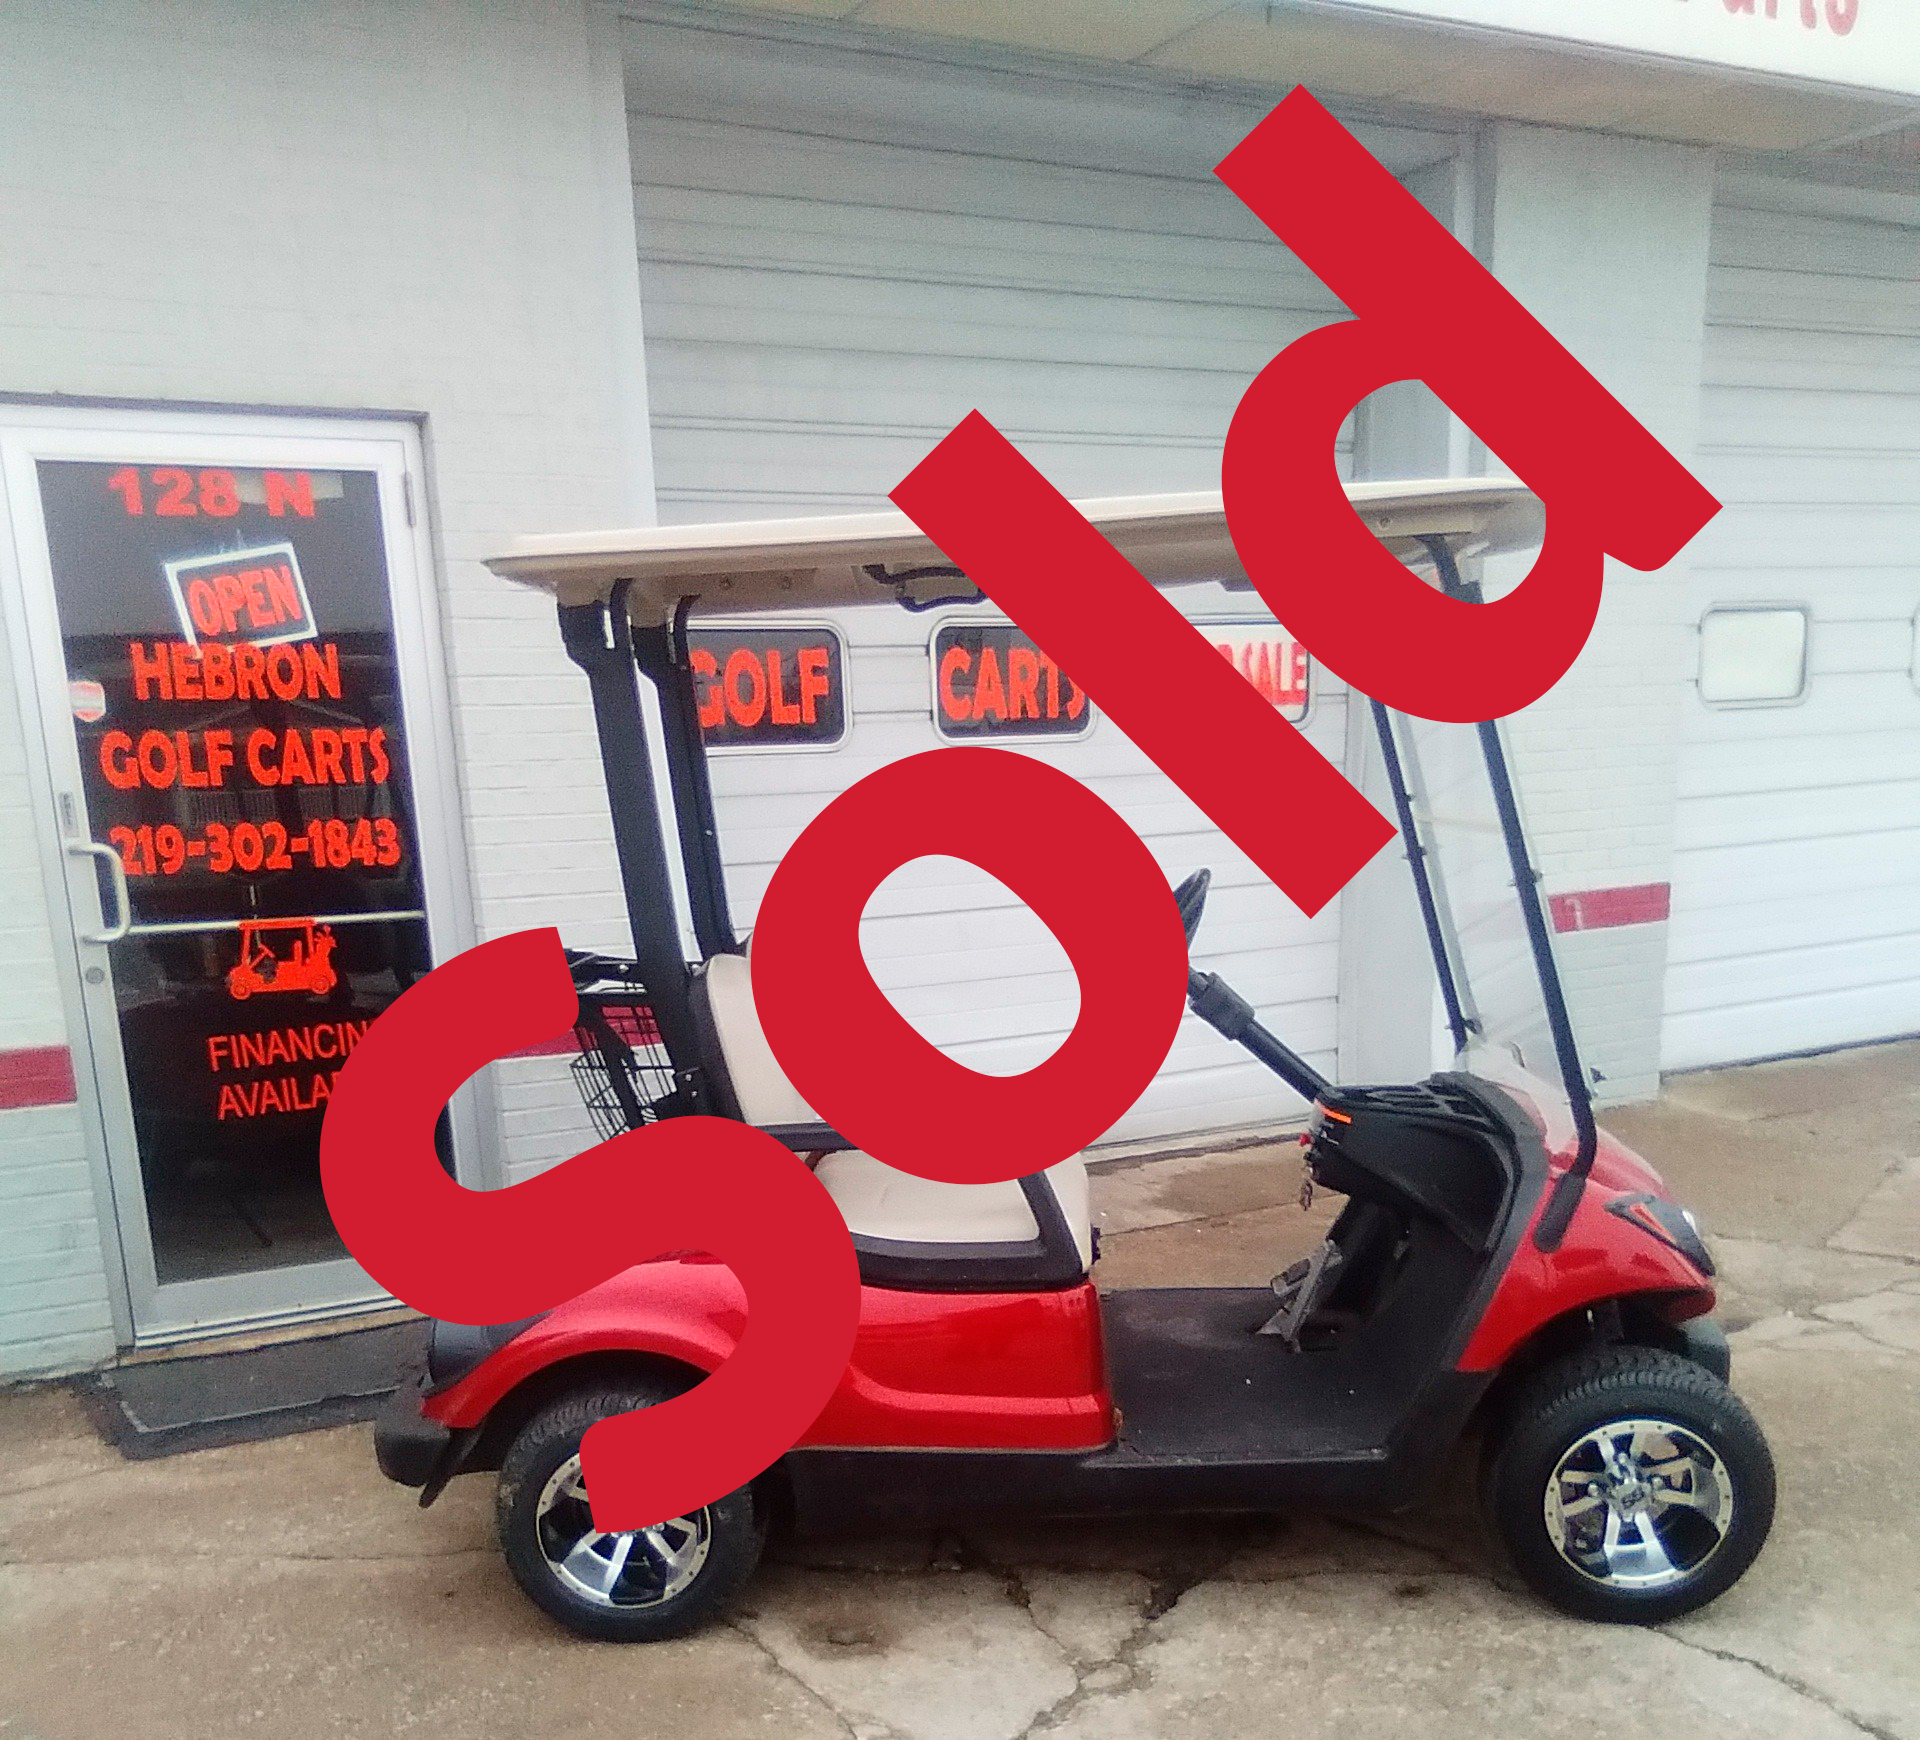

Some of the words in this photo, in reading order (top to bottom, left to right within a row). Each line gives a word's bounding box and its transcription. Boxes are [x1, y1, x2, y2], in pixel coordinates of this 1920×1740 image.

[108, 467, 240, 517] 128
[264, 471, 316, 518] N
[188, 563, 303, 637] OPEN
[130, 641, 343, 701] HEBRON
[689, 647, 831, 729] GOLF
[100, 728, 235, 790] GOLF
[247, 726, 390, 787] CARTS
[109, 817, 402, 877] 219-302-1843
[207, 1017, 376, 1072] FINANCIN
[217, 1070, 341, 1121] AVAILA
